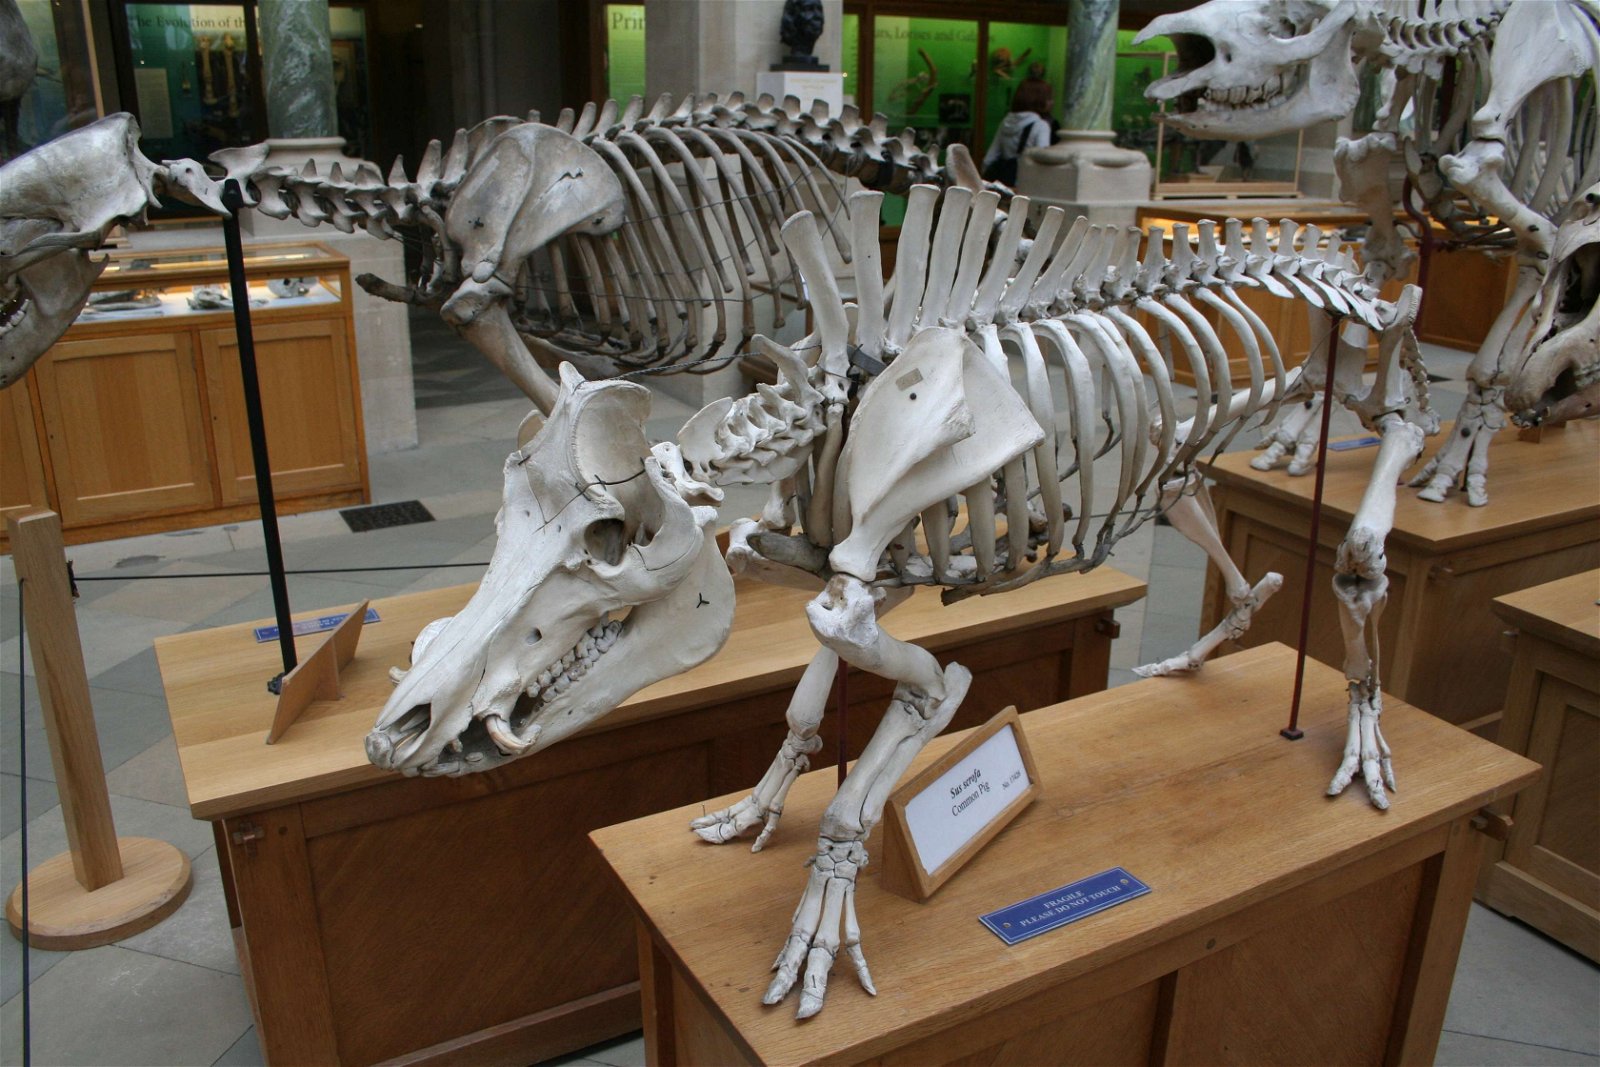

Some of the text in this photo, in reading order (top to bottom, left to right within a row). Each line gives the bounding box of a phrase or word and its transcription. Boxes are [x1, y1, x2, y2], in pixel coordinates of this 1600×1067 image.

[218, 16, 231, 28] of
[950, 768, 982, 799] Sus scrofa
[951, 781, 991, 817] Common Pig
[1020, 884, 1122, 927] PLEASE DO NOT TOUCH
[1043, 890, 1085, 909] FRAGILE
